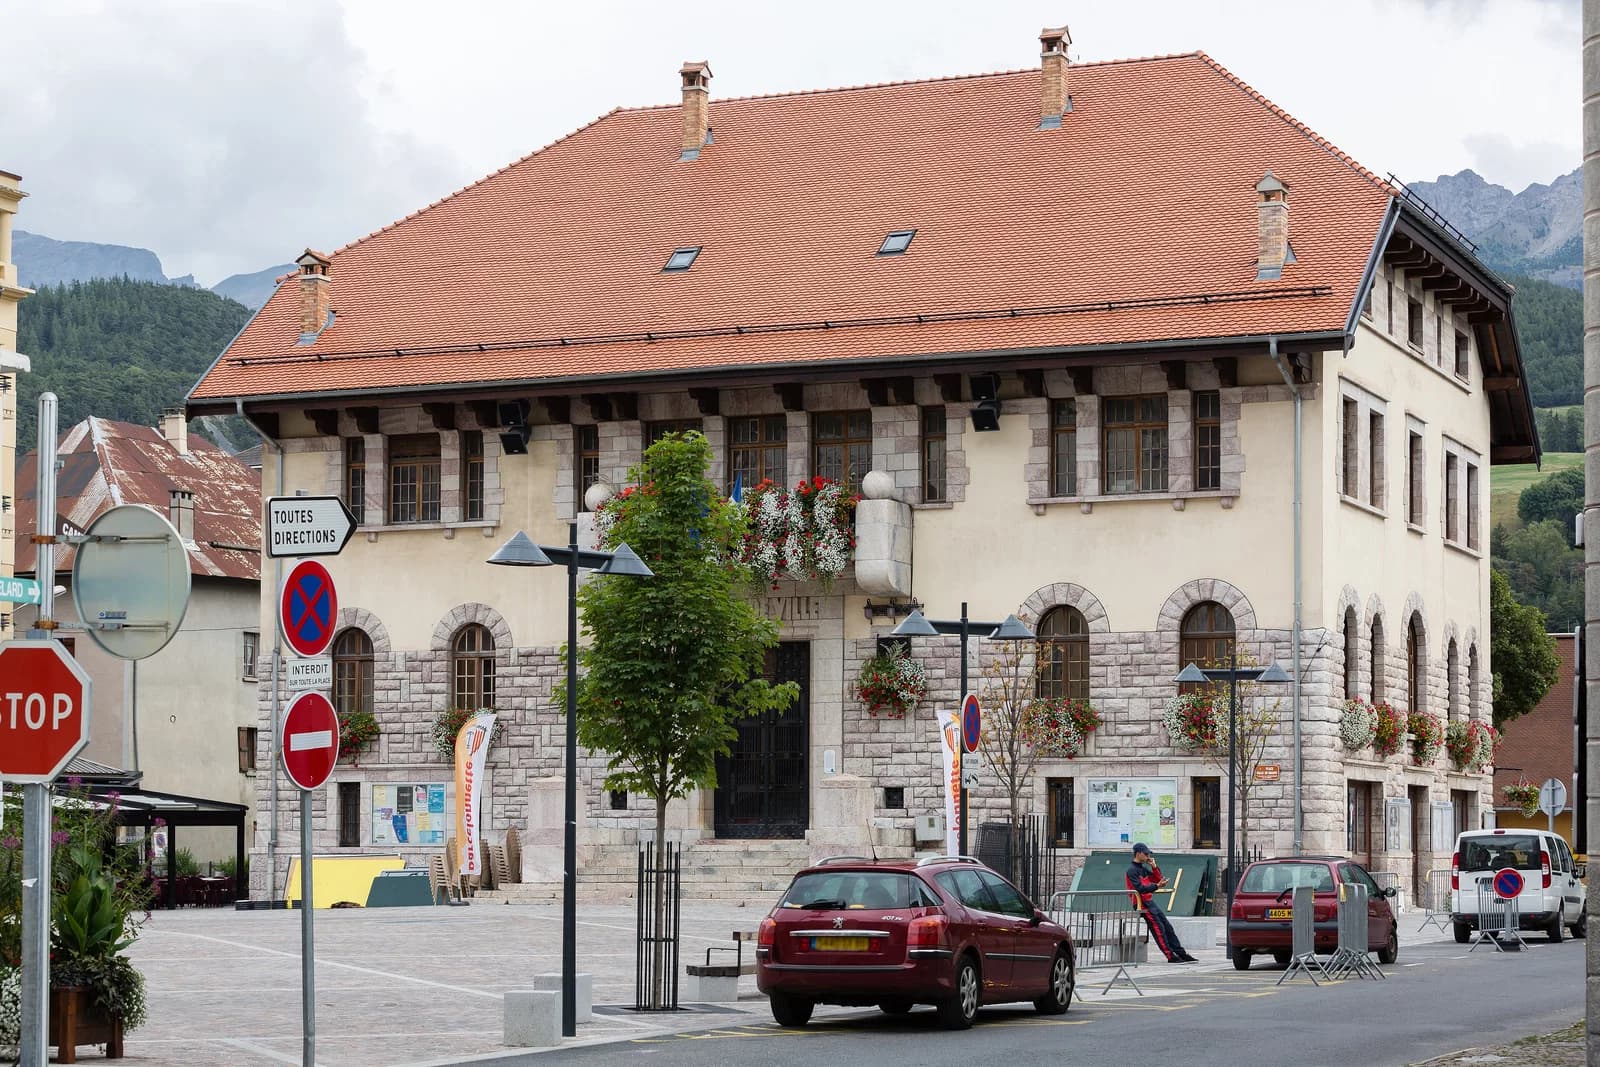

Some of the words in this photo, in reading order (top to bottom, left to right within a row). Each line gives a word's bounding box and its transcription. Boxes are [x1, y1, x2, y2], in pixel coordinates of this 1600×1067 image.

[274, 510, 313, 524] TOUTES
[274, 529, 336, 545] DIRECTIONS
[292, 664, 328, 675] INTERDIT
[0, 692, 73, 730] TOP
